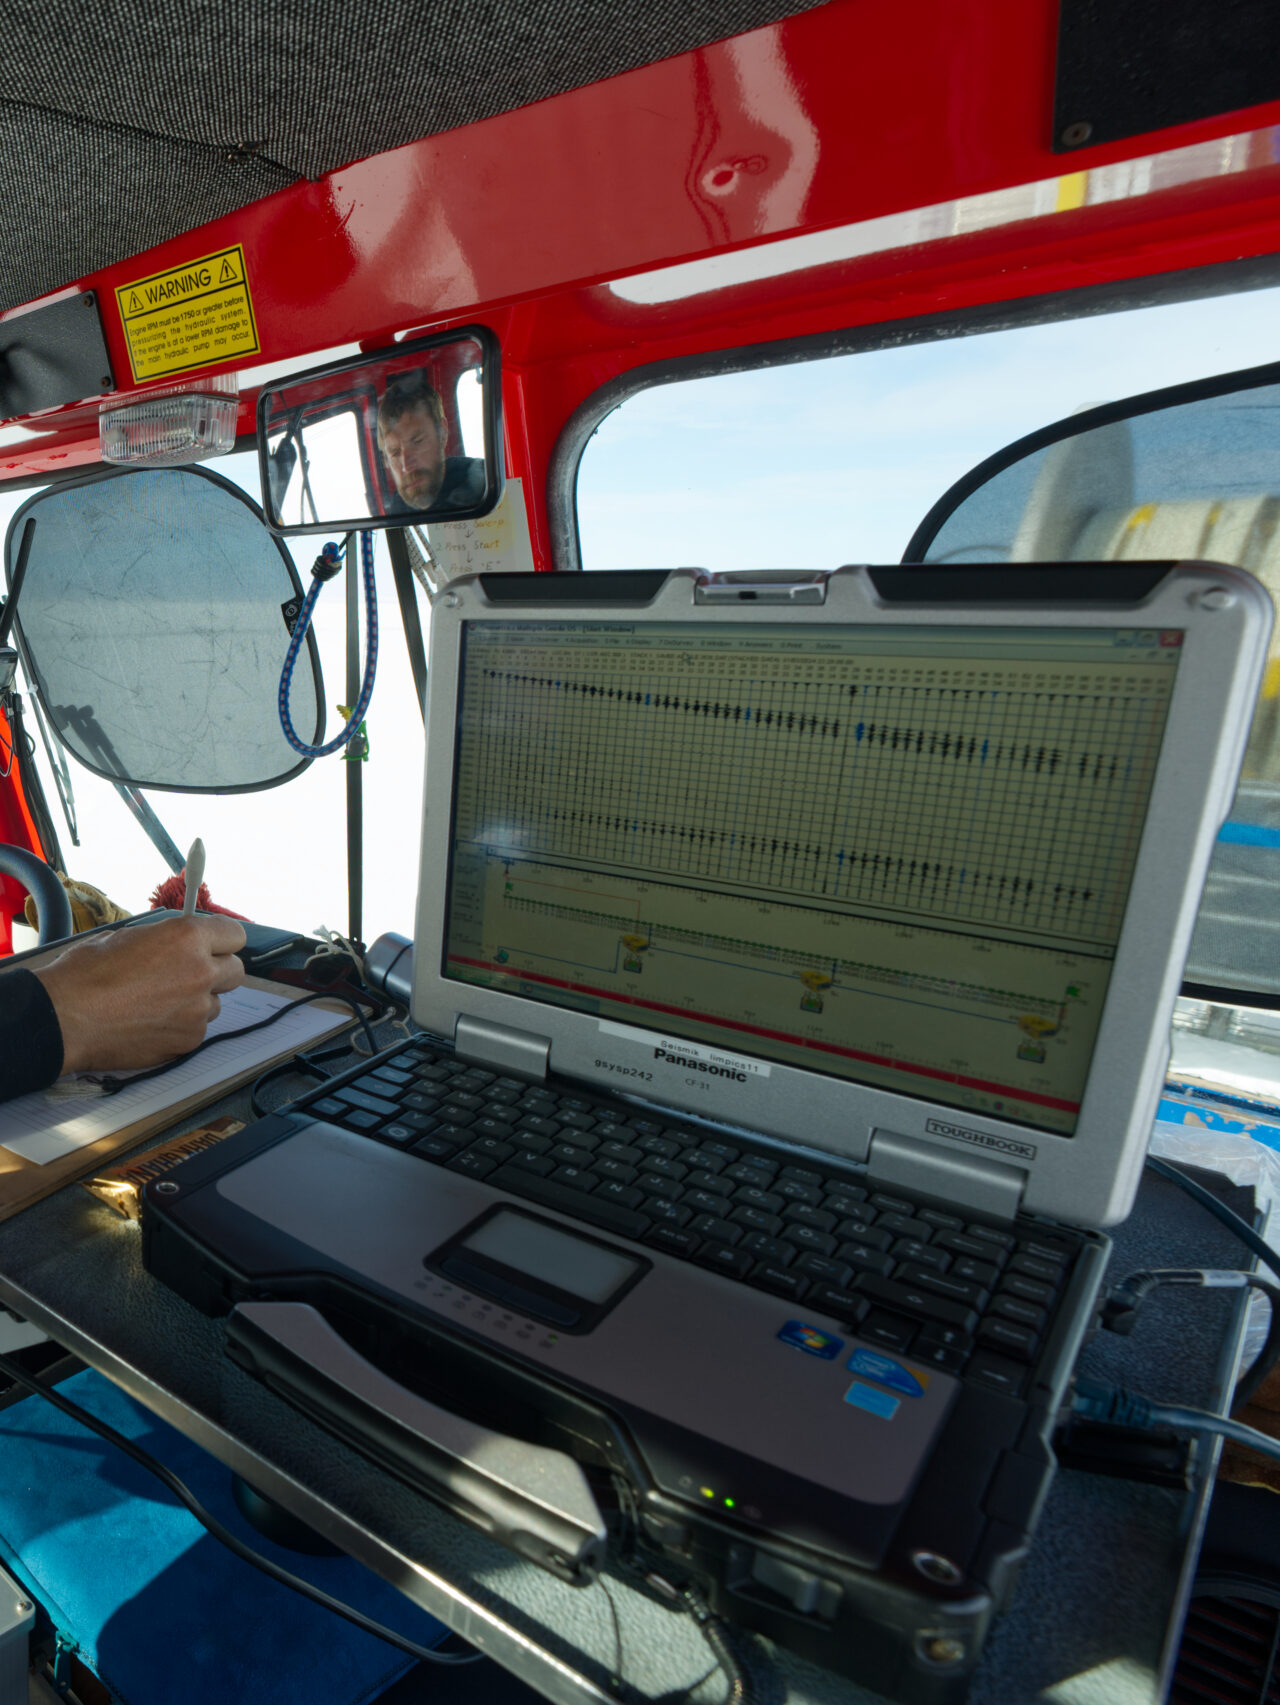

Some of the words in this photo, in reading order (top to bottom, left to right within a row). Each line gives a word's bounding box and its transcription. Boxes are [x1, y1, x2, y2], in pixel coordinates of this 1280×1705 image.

[144, 268, 211, 304] WARNING
[129, 326, 146, 336] Engine
[147, 321, 158, 330] RPM
[159, 318, 171, 326] must
[172, 316, 180, 324] be
[180, 310, 195, 320] 1750
[202, 302, 223, 316] greater
[224, 296, 244, 308] before
[132, 332, 166, 348] pressurizing
[185, 316, 216, 331] hydraulic
[148, 342, 166, 352] engine
[184, 332, 200, 342] lower
[200, 328, 213, 338] RPM
[214, 322, 240, 334] damage
[242, 318, 248, 326] to
[136, 359, 144, 367] the
[148, 355, 161, 363] main
[164, 346, 189, 360] hydraulic
[193, 342, 210, 352] pump
[214, 337, 227, 347] may
[446, 542, 466, 551] Press
[474, 540, 499, 550] Start
[654, 1048, 748, 1083] Panasonic
[661, 1040, 699, 1056] Seismik
[710, 1054, 760, 1073] limpics11
[594, 1059, 654, 1082] gsysp242
[685, 1078, 710, 1091] CF-31
[931, 1122, 1032, 1157] TOUGHBOOK
